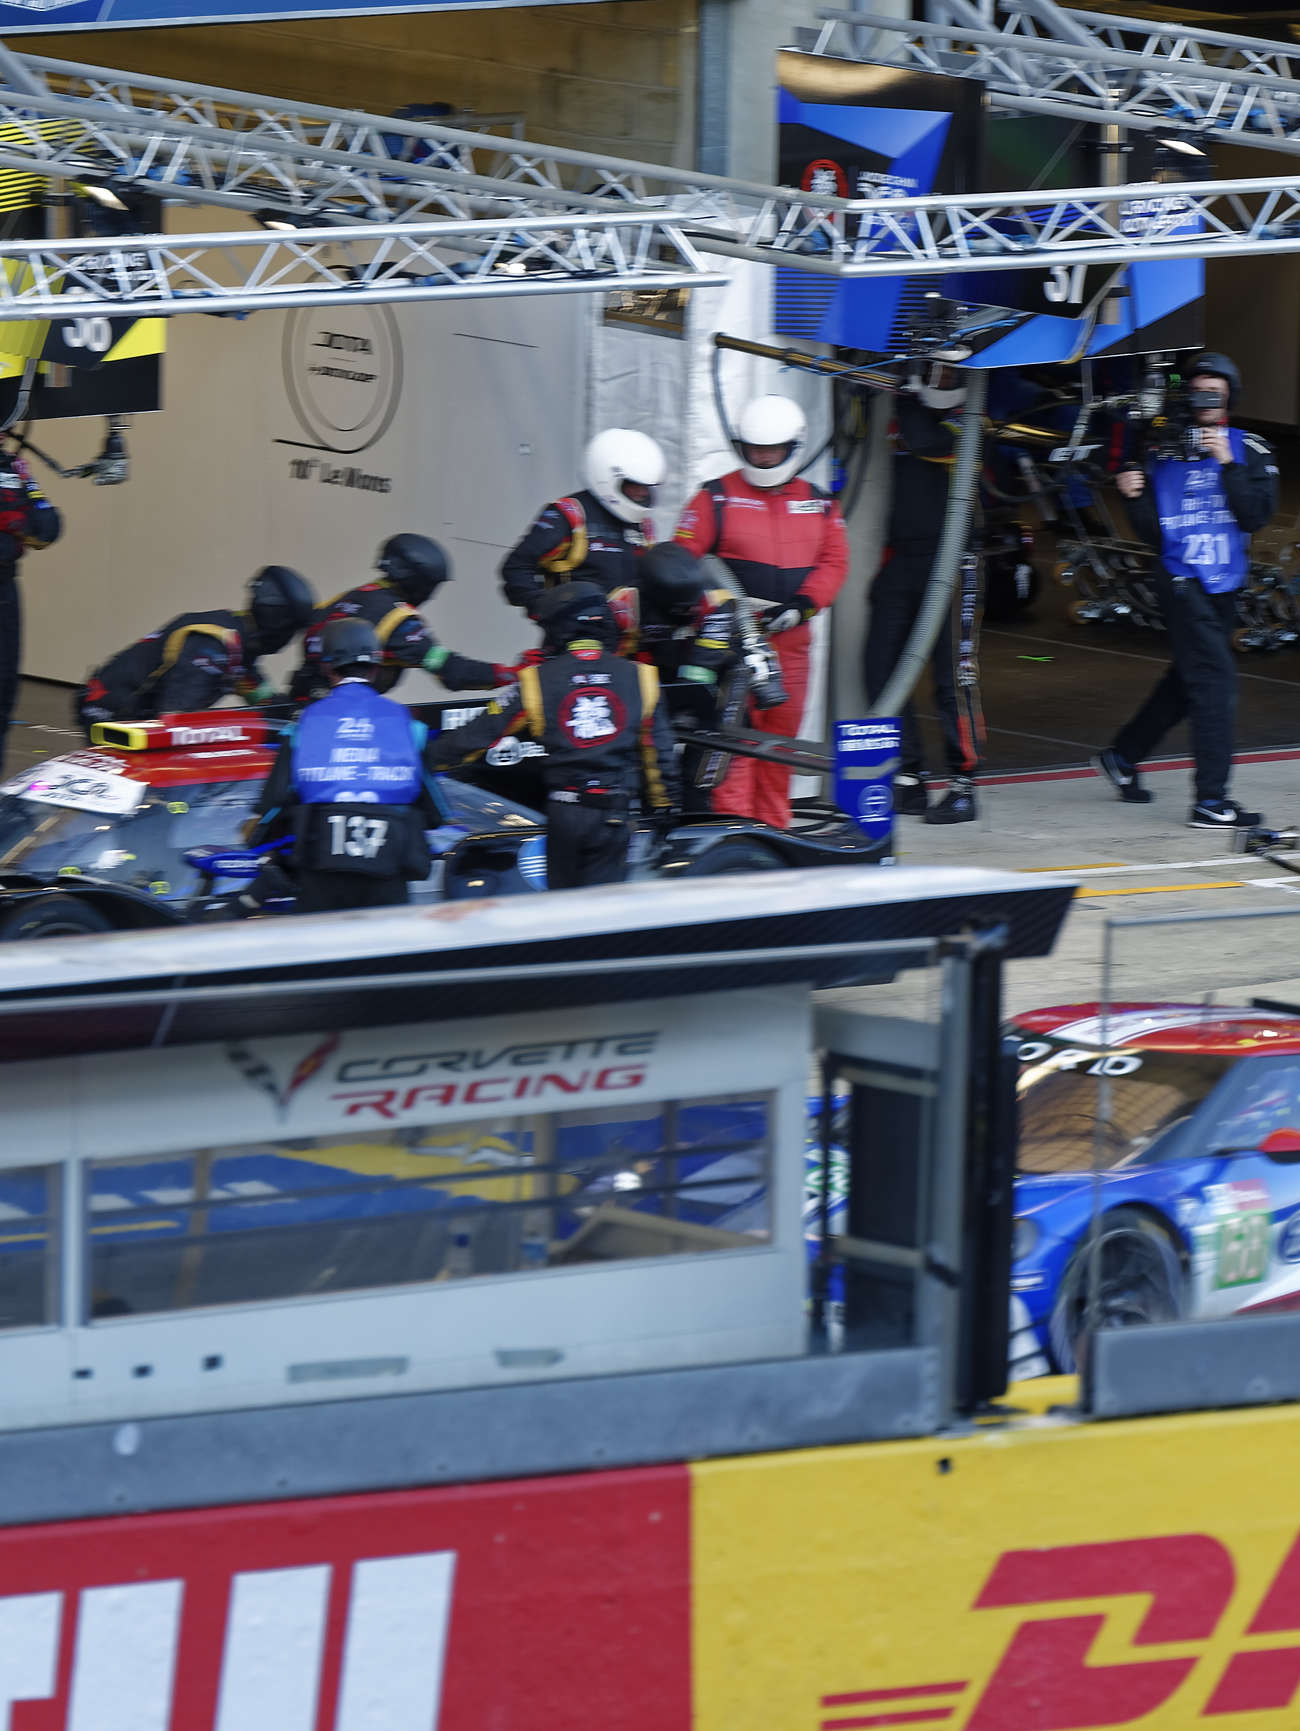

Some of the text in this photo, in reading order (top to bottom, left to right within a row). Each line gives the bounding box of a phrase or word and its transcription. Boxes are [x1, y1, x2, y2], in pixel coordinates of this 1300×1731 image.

[1181, 533, 1231, 565] 231
[167, 725, 251, 746] TOTAL
[838, 723, 901, 737] TOTAL
[327, 814, 389, 859] 137
[336, 1030, 660, 1083] CORVETTE
[330, 1063, 650, 1119] RACING
